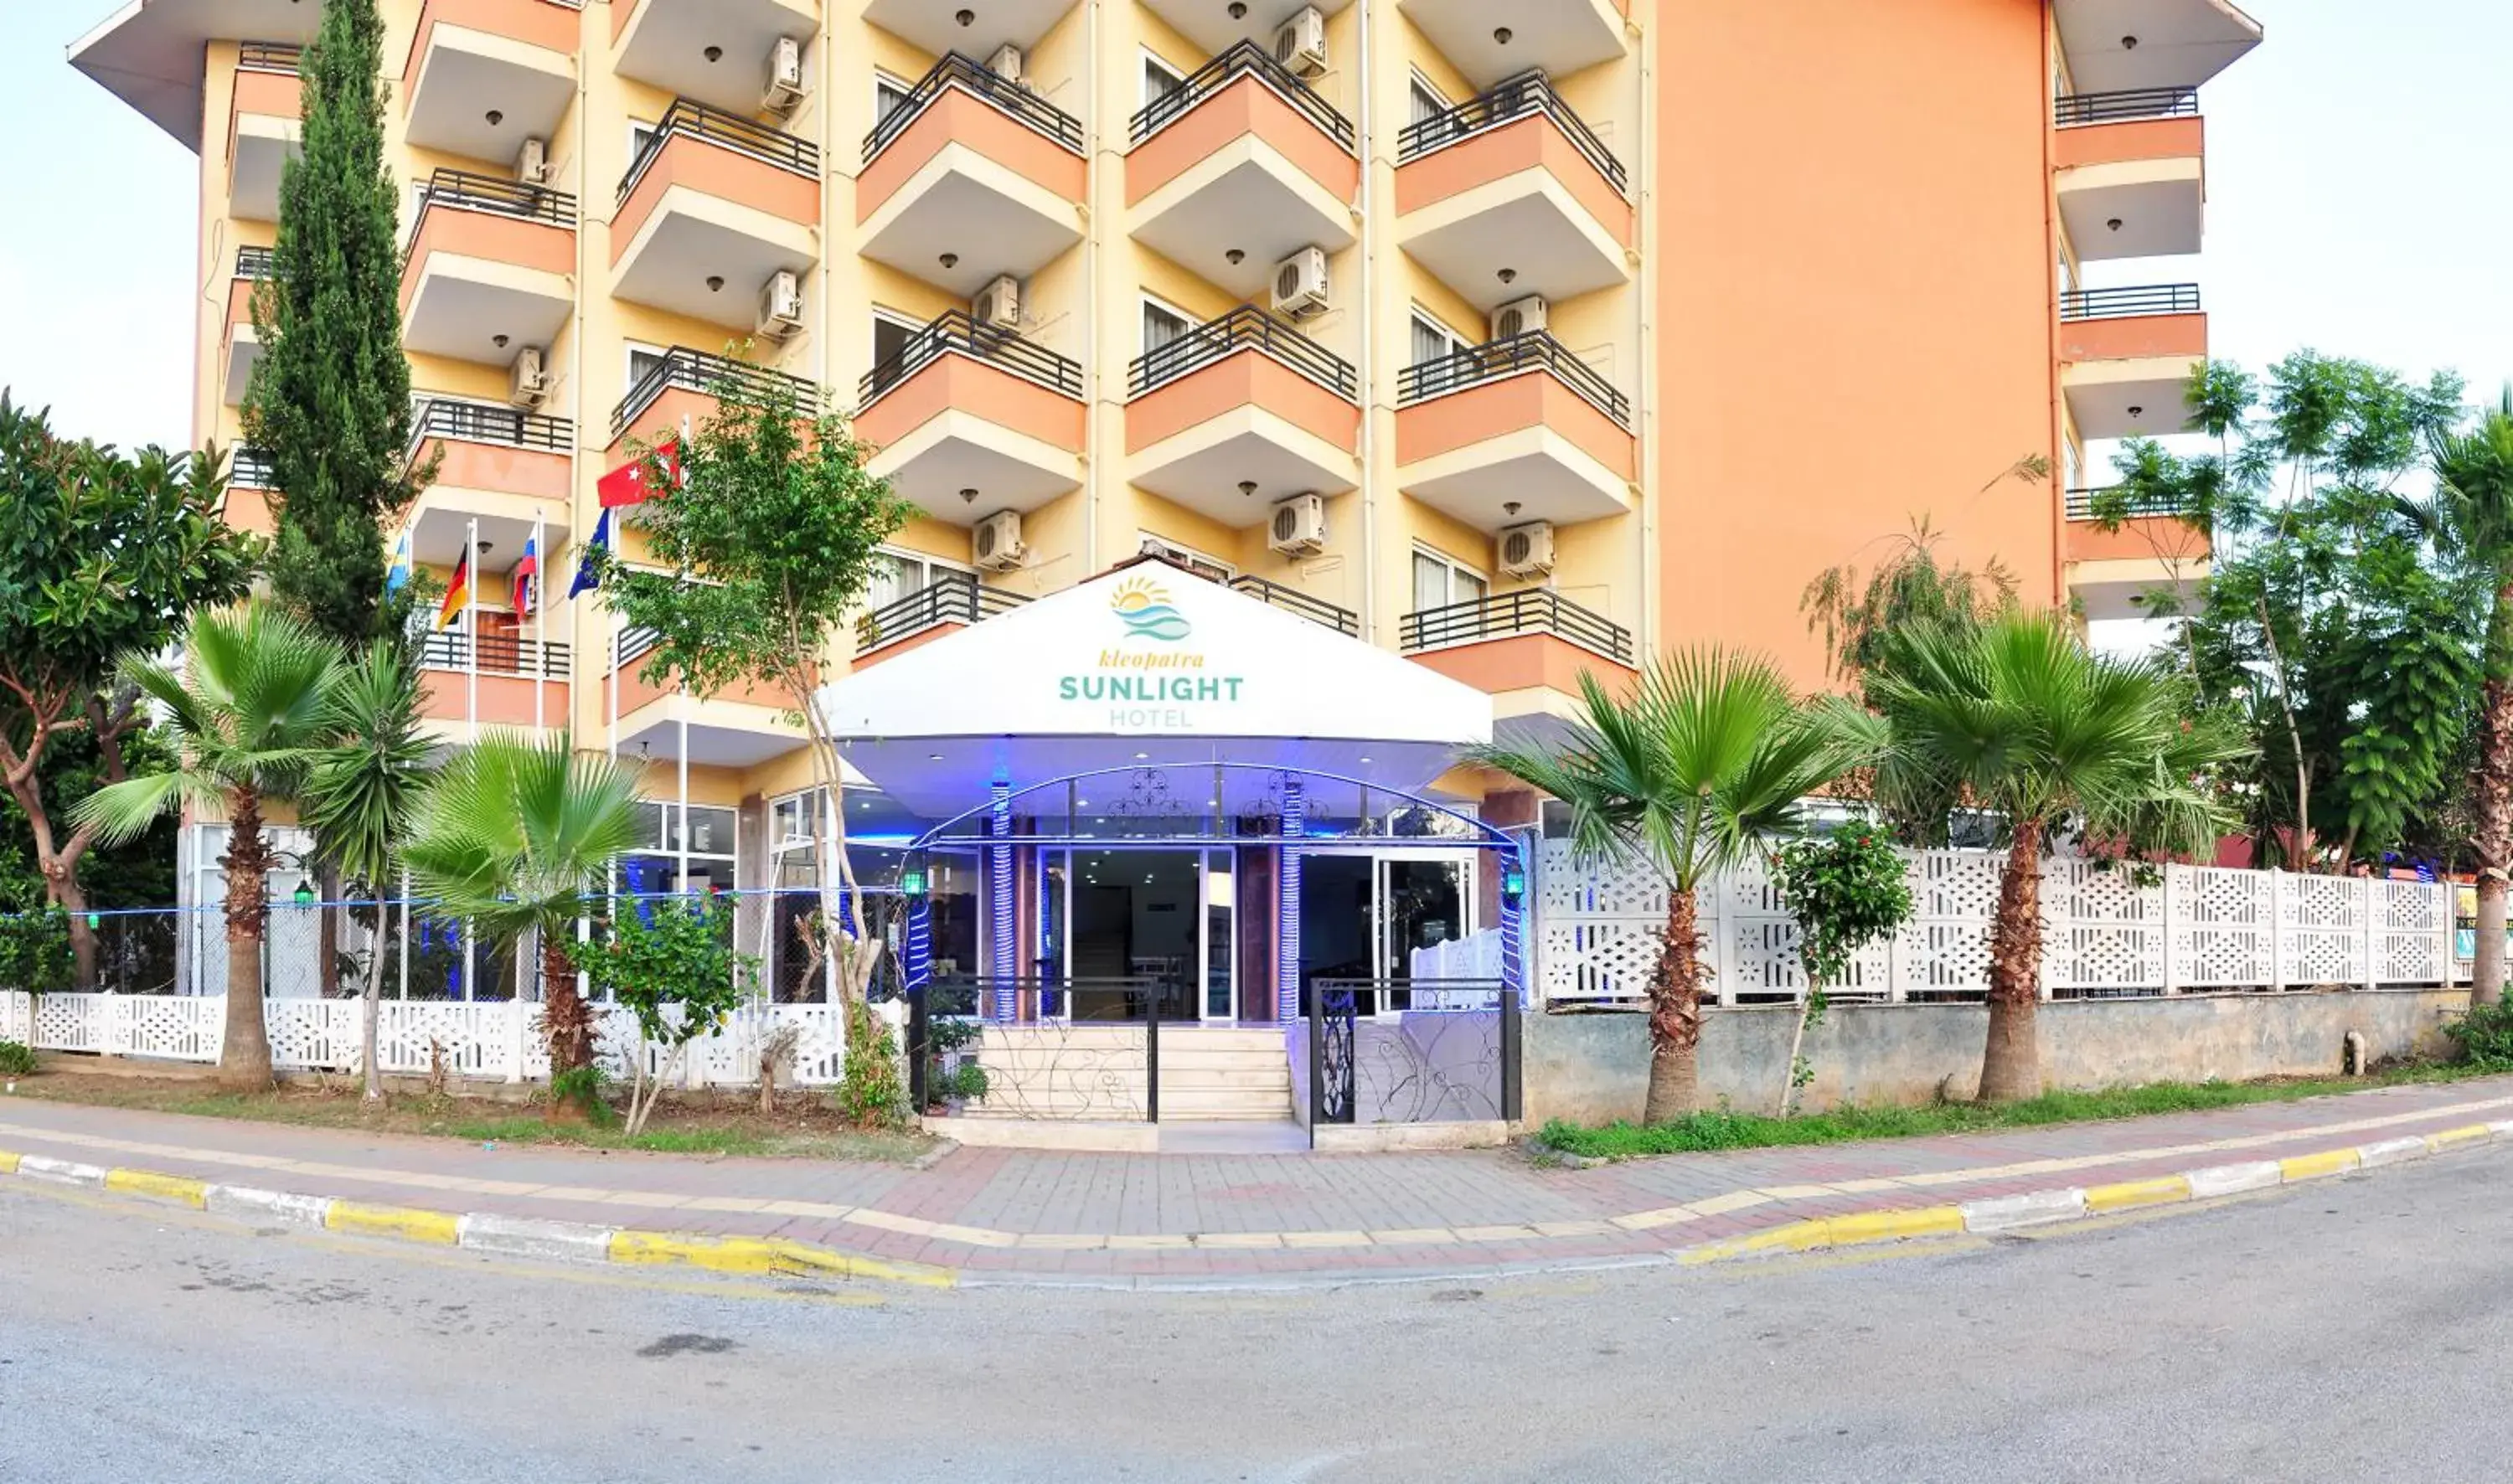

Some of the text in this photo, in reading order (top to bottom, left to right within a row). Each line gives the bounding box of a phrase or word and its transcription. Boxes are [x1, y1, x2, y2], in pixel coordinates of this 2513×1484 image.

[1098, 649, 1204, 670] kleopatra
[1059, 675, 1244, 702] SUNLIGHT
[1110, 709, 1193, 727] HOTEL
